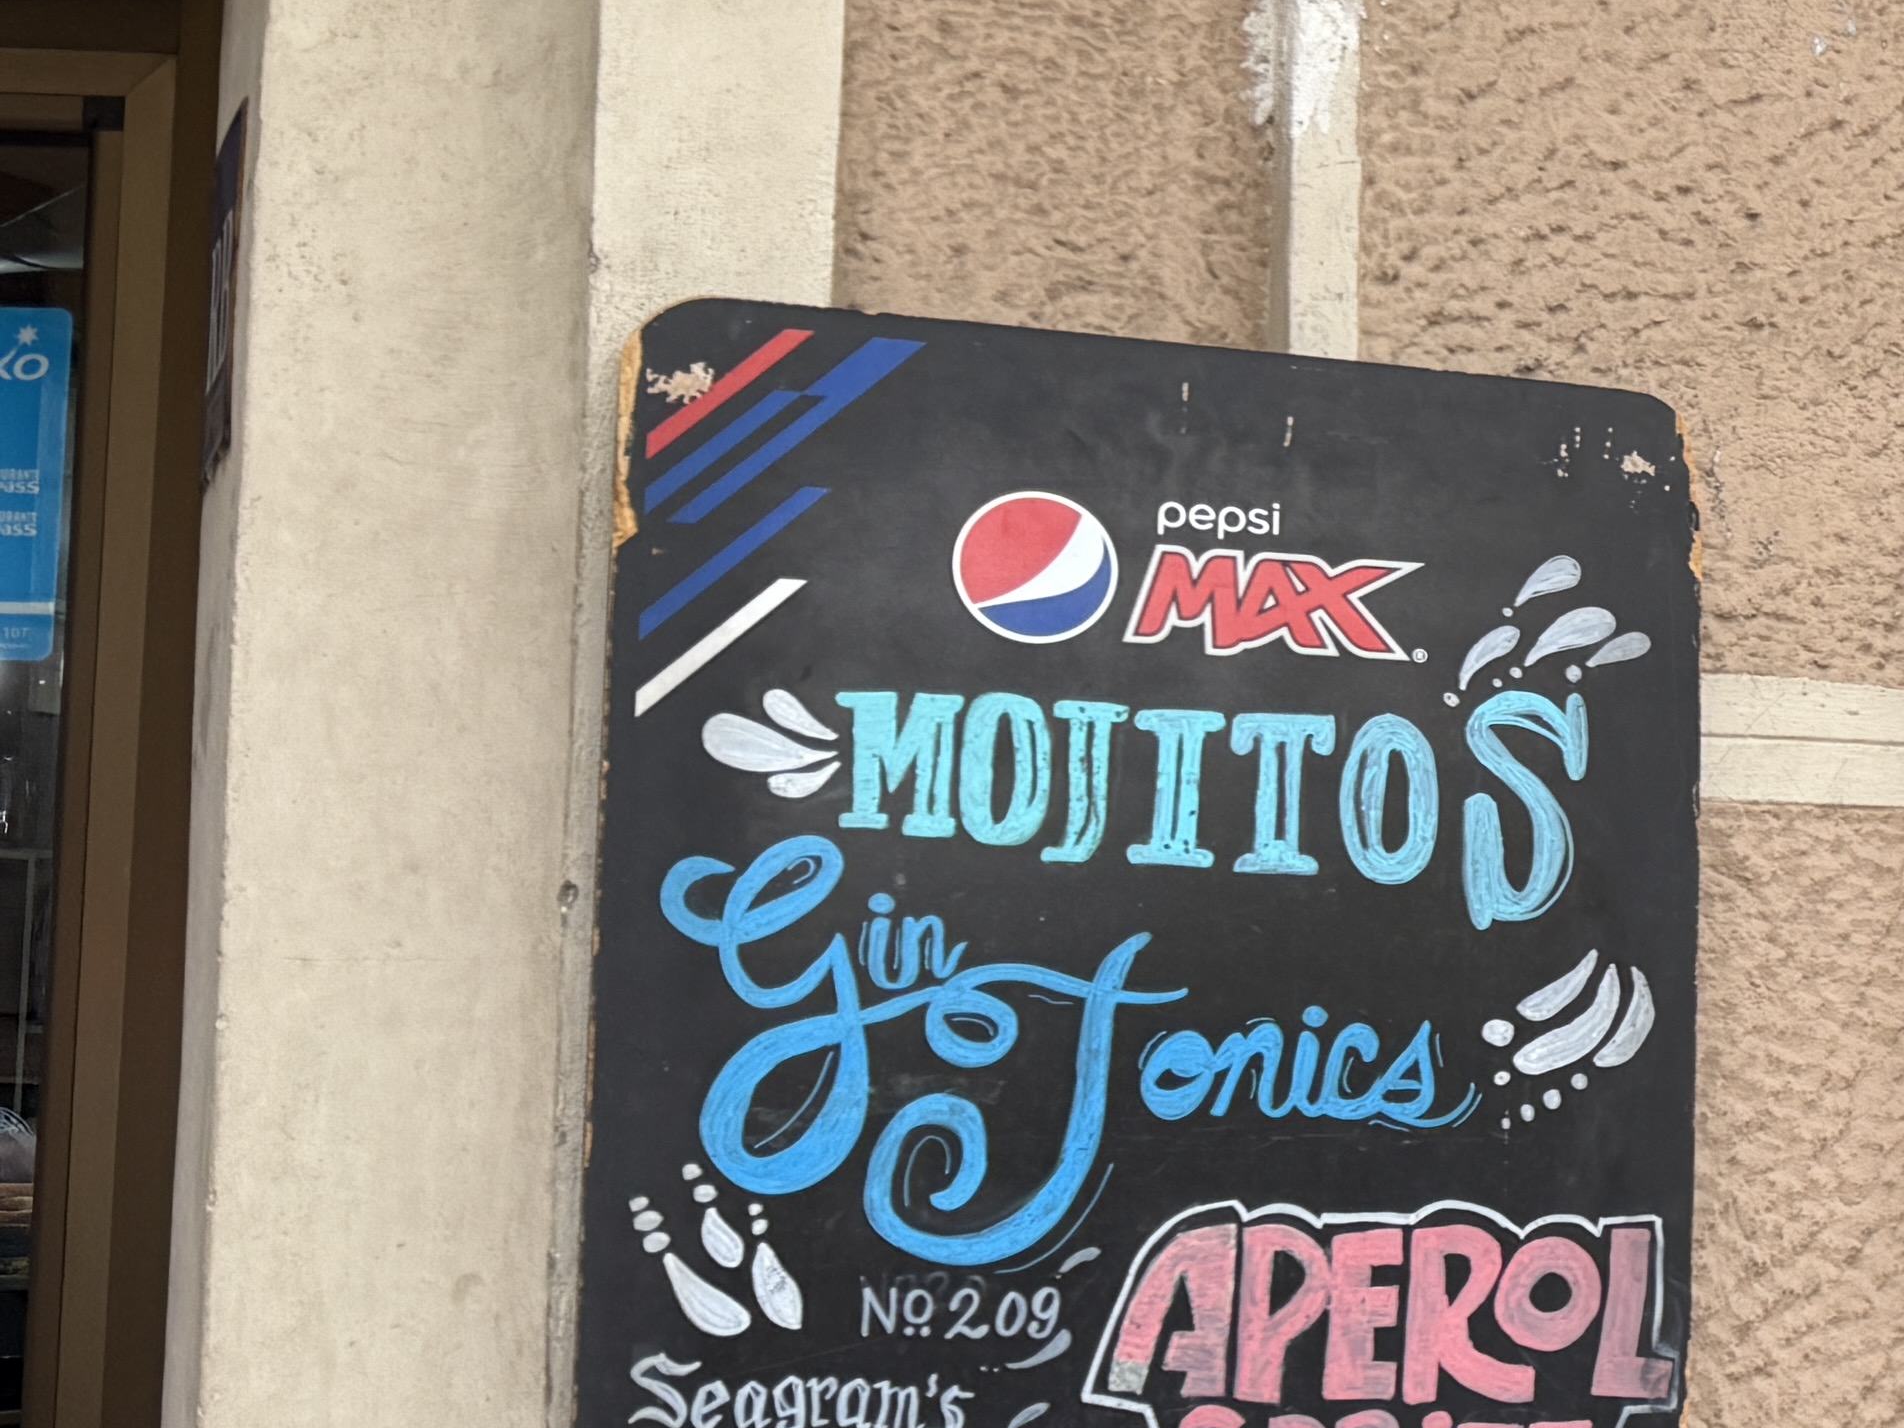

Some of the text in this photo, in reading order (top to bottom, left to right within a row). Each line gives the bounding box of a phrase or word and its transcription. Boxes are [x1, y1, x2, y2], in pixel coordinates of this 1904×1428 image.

[1123, 543, 1425, 661] MAX
[1157, 500, 1281, 540] pepsi
[836, 691, 1588, 929] MOJITOS
[660, 834, 965, 1196] Gin
[865, 933, 1478, 1265] Tonics
[1109, 1224, 1676, 1406] APEROL
